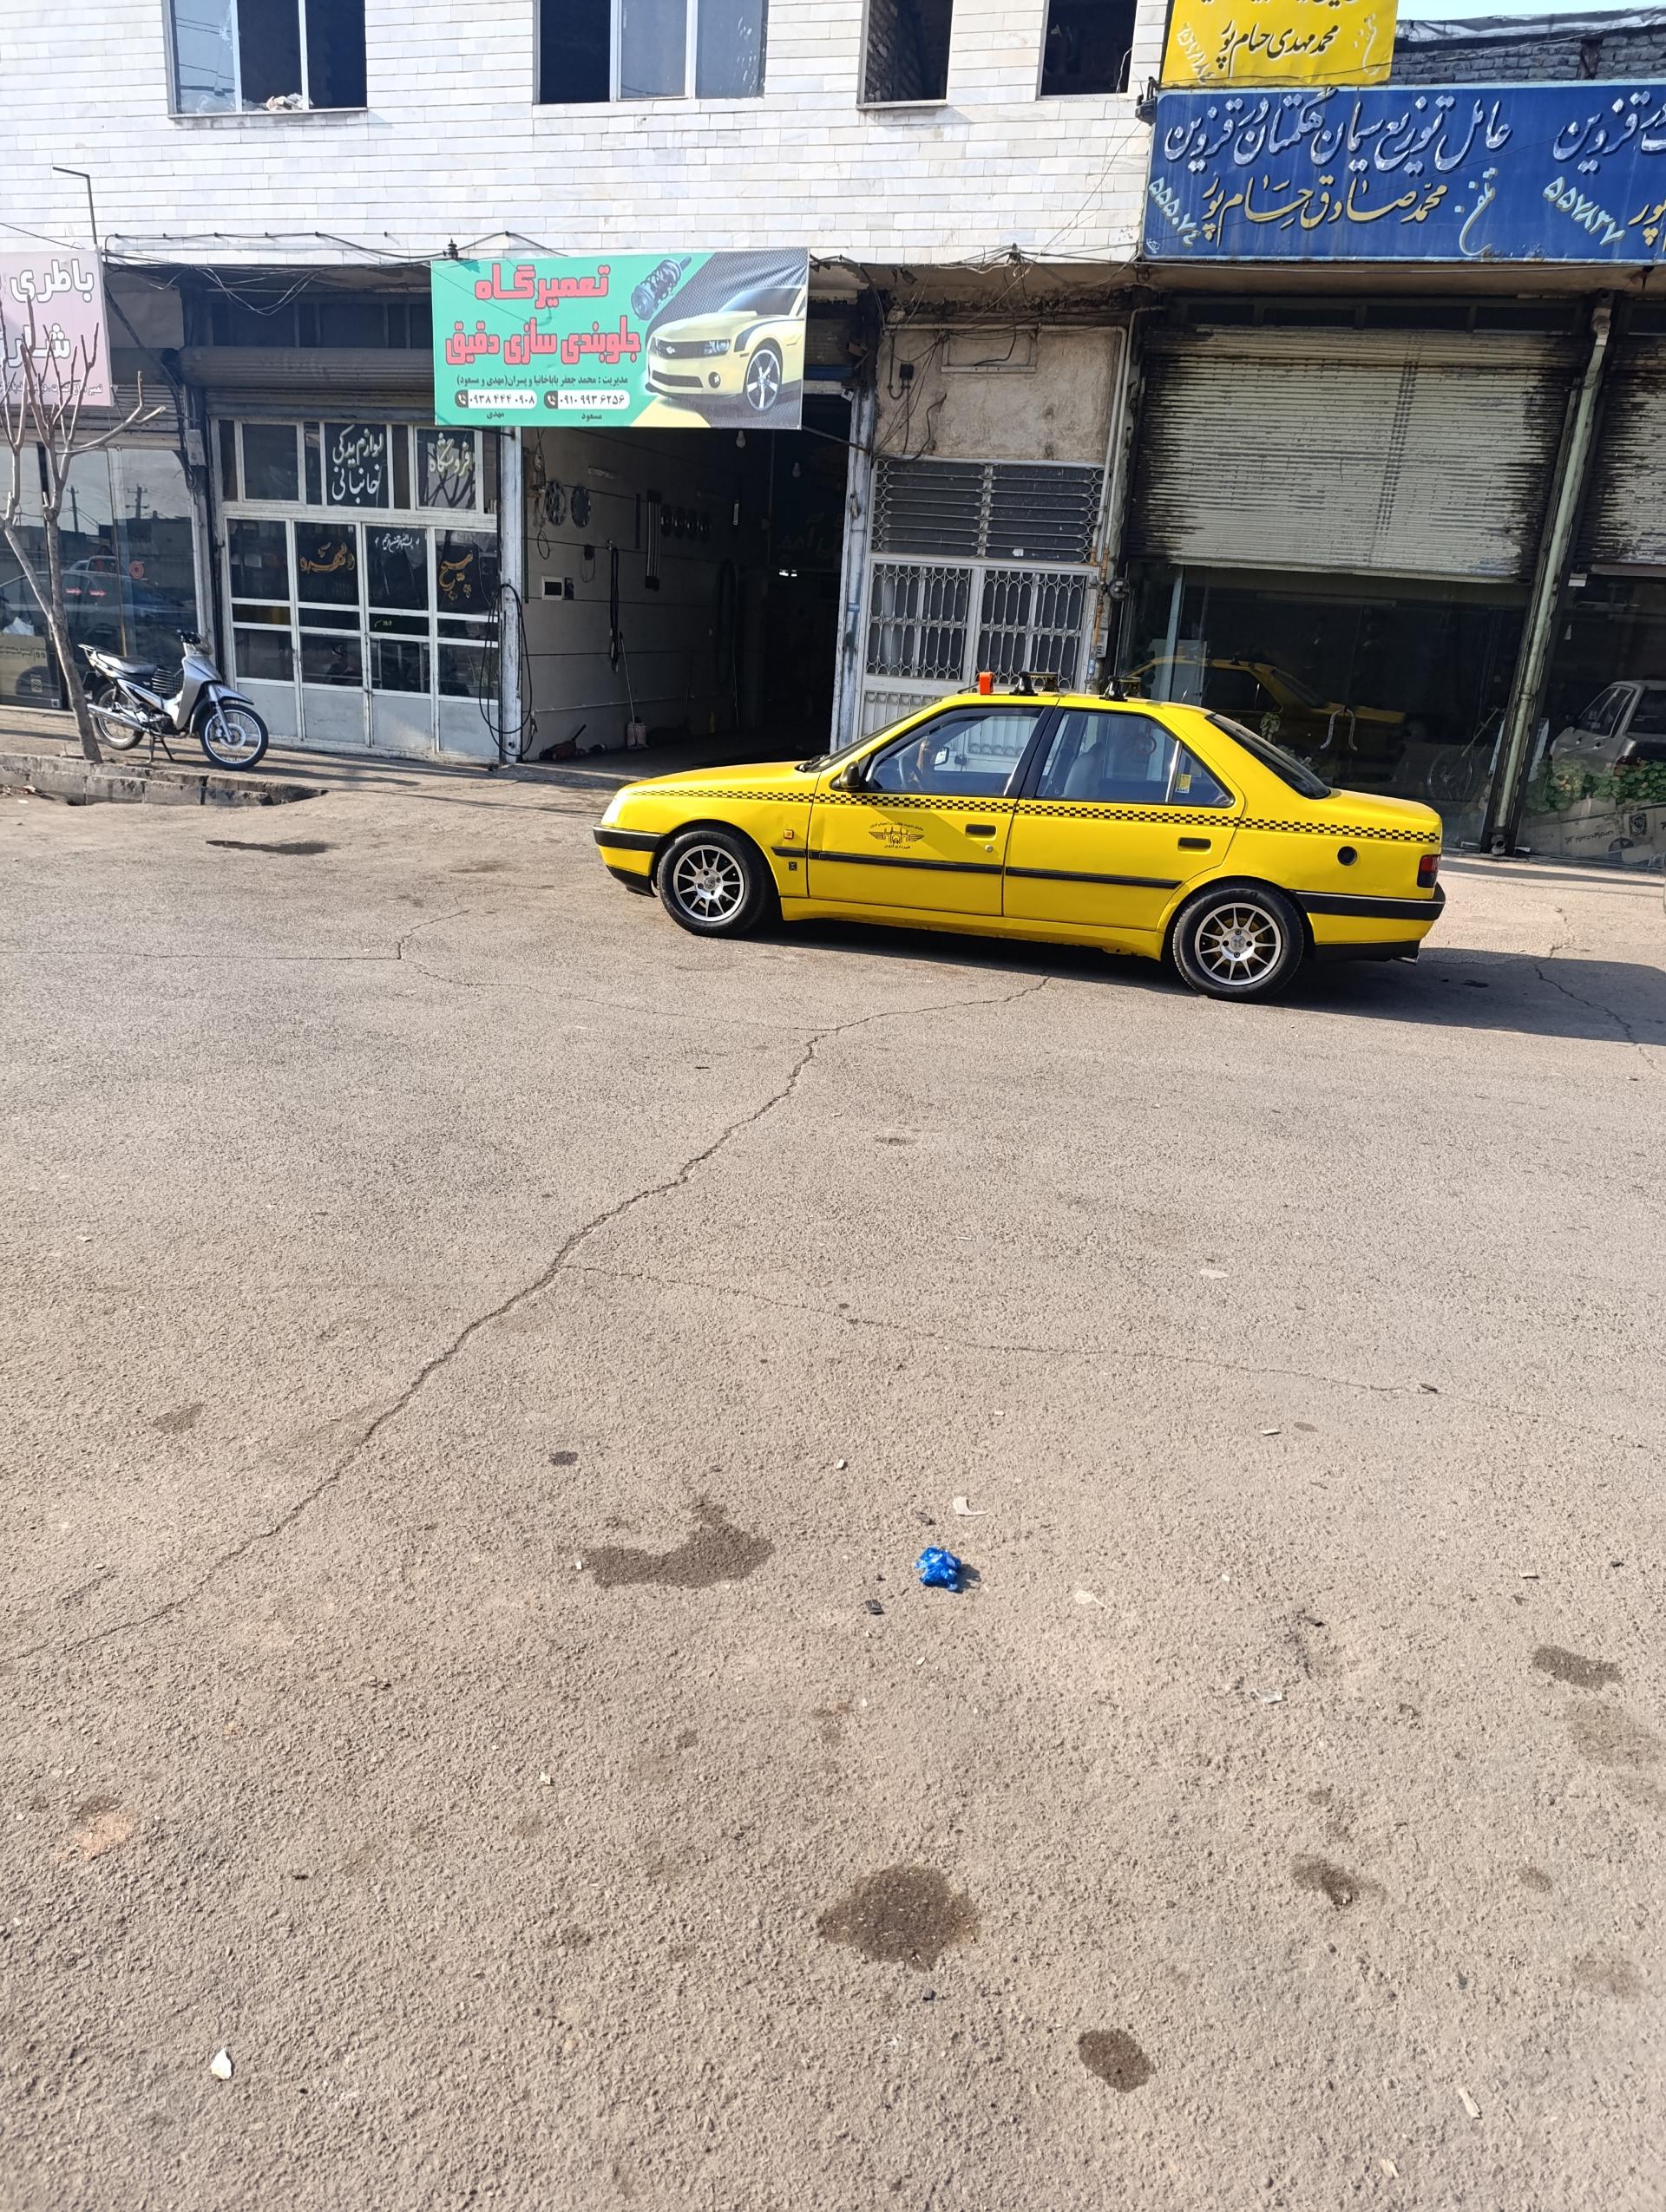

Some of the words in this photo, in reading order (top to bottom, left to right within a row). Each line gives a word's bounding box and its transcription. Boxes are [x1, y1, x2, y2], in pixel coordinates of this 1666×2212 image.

[1215, 20, 1236, 69] پور
[1228, 23, 1273, 78] حسام
[1267, 28, 1317, 59] مهدی
[1309, 24, 1341, 56] محمد
[1164, 97, 1243, 173] قزوین
[1238, 98, 1270, 128] در
[1374, 95, 1455, 173] توزیع
[1434, 98, 1512, 171] عامل
[1552, 91, 1651, 173] قزوین
[1310, 101, 1385, 172] سیمان
[1300, 174, 1417, 229] صادق
[1454, 167, 1499, 256] تلفن
[1542, 176, 1626, 245] ۵۵۷۸۳۷
[10, 259, 95, 303] باطری
[475, 263, 611, 309] تعمیرگاه
[445, 320, 501, 364] دقیق
[503, 317, 557, 364] سازی
[561, 315, 642, 364] جلوبندی
[469, 395, 491, 404] ۰۹۳۸
[494, 395, 512, 404] ۴۴۴
[515, 395, 535, 404] ۰۹۰۸
[560, 395, 578, 405] ۰۹۱۰
[580, 395, 598, 405] ۹۹۳
[561, 375, 576, 387] جعفر
[578, 376, 597, 384] محمد
[602, 375, 628, 387] مدیریت
[581, 413, 602, 422] مسعود
[332, 424, 357, 468] یدکی
[356, 428, 384, 466] لوازم
[430, 432, 472, 477] فروشگاه
